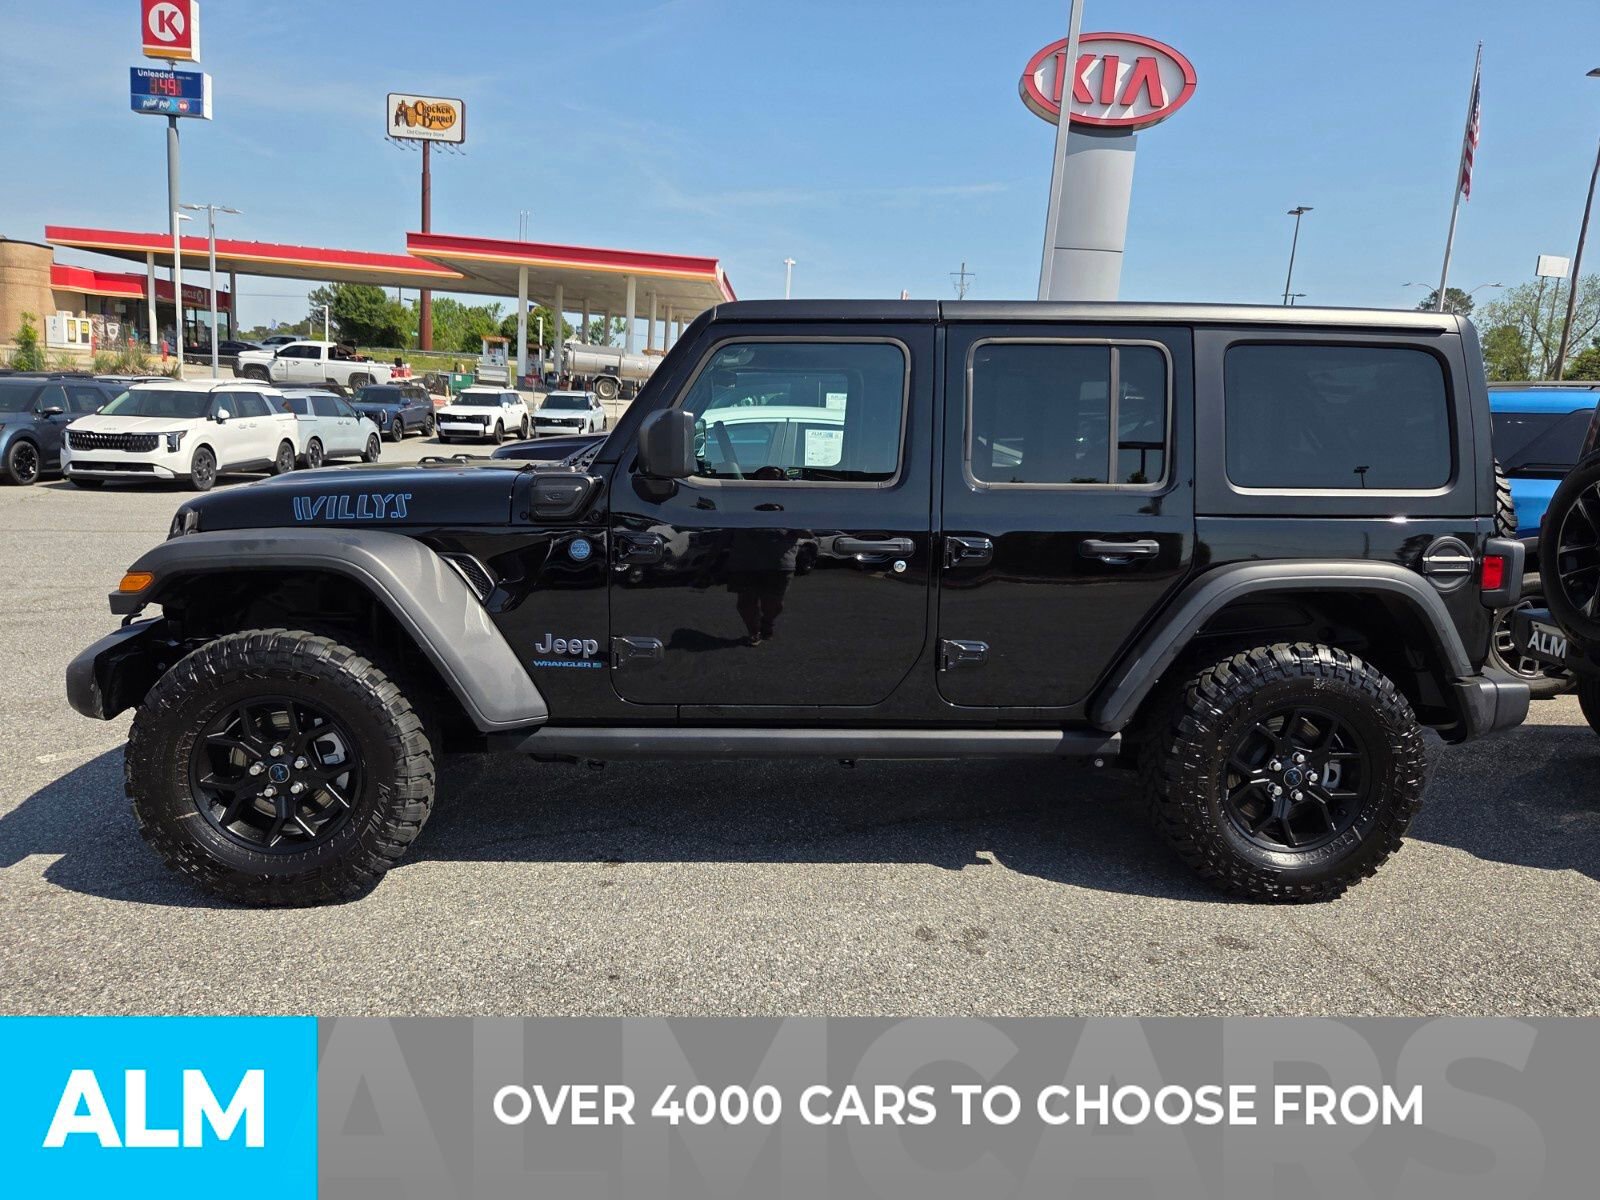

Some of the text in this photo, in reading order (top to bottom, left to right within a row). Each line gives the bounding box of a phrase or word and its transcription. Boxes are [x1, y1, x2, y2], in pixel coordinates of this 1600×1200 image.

[158, 10, 183, 41] K
[137, 69, 175, 79] Unleaded
[1053, 52, 1165, 108] KIA
[293, 493, 412, 520] WILLYS
[534, 633, 599, 659] Jeep
[1527, 630, 1567, 659] ALM
[533, 660, 592, 668] WRANGLER
